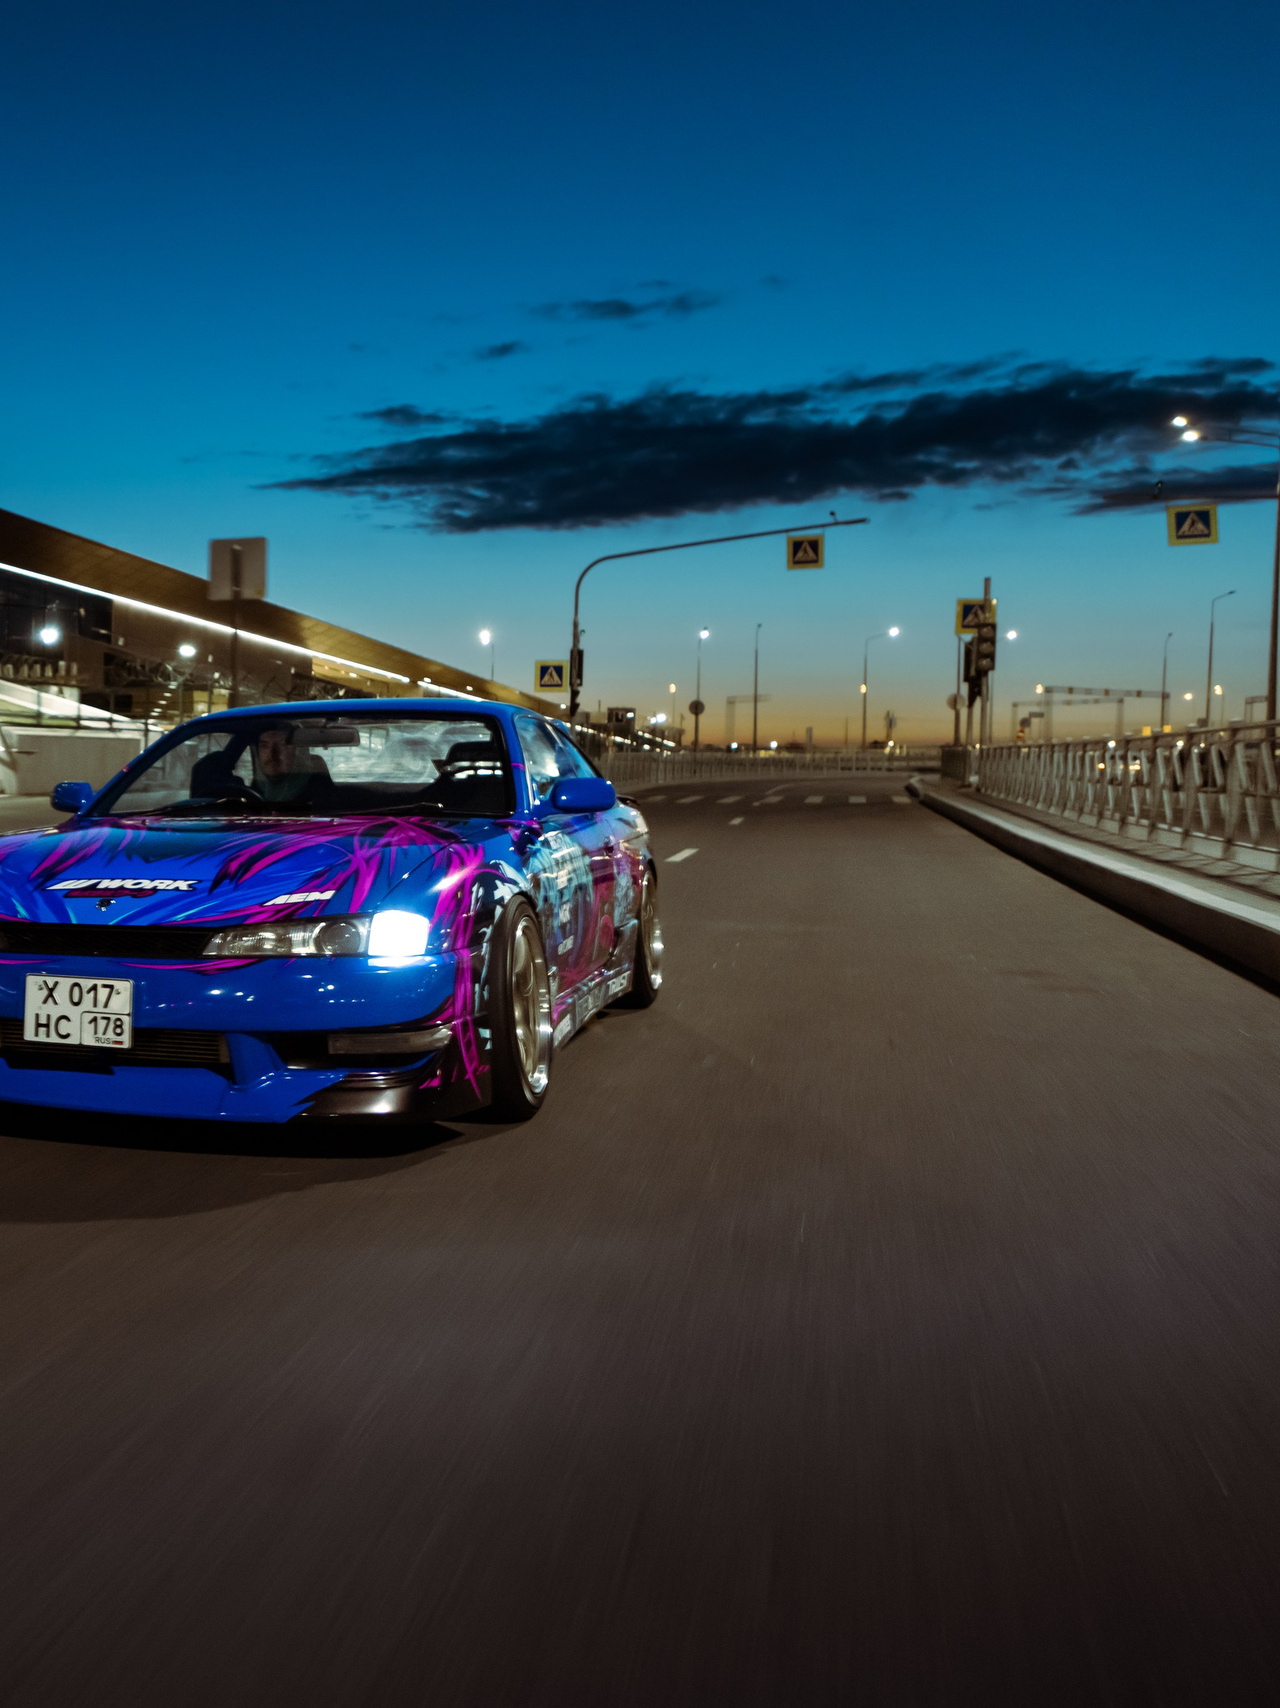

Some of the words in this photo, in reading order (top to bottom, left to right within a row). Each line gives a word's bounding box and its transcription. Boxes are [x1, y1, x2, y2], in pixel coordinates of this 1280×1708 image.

[96, 879, 198, 890] WORK
[263, 890, 336, 906] AEM
[68, 982, 114, 1009] 017
[88, 1016, 124, 1036] 178
[94, 1036, 111, 1045] RUS
